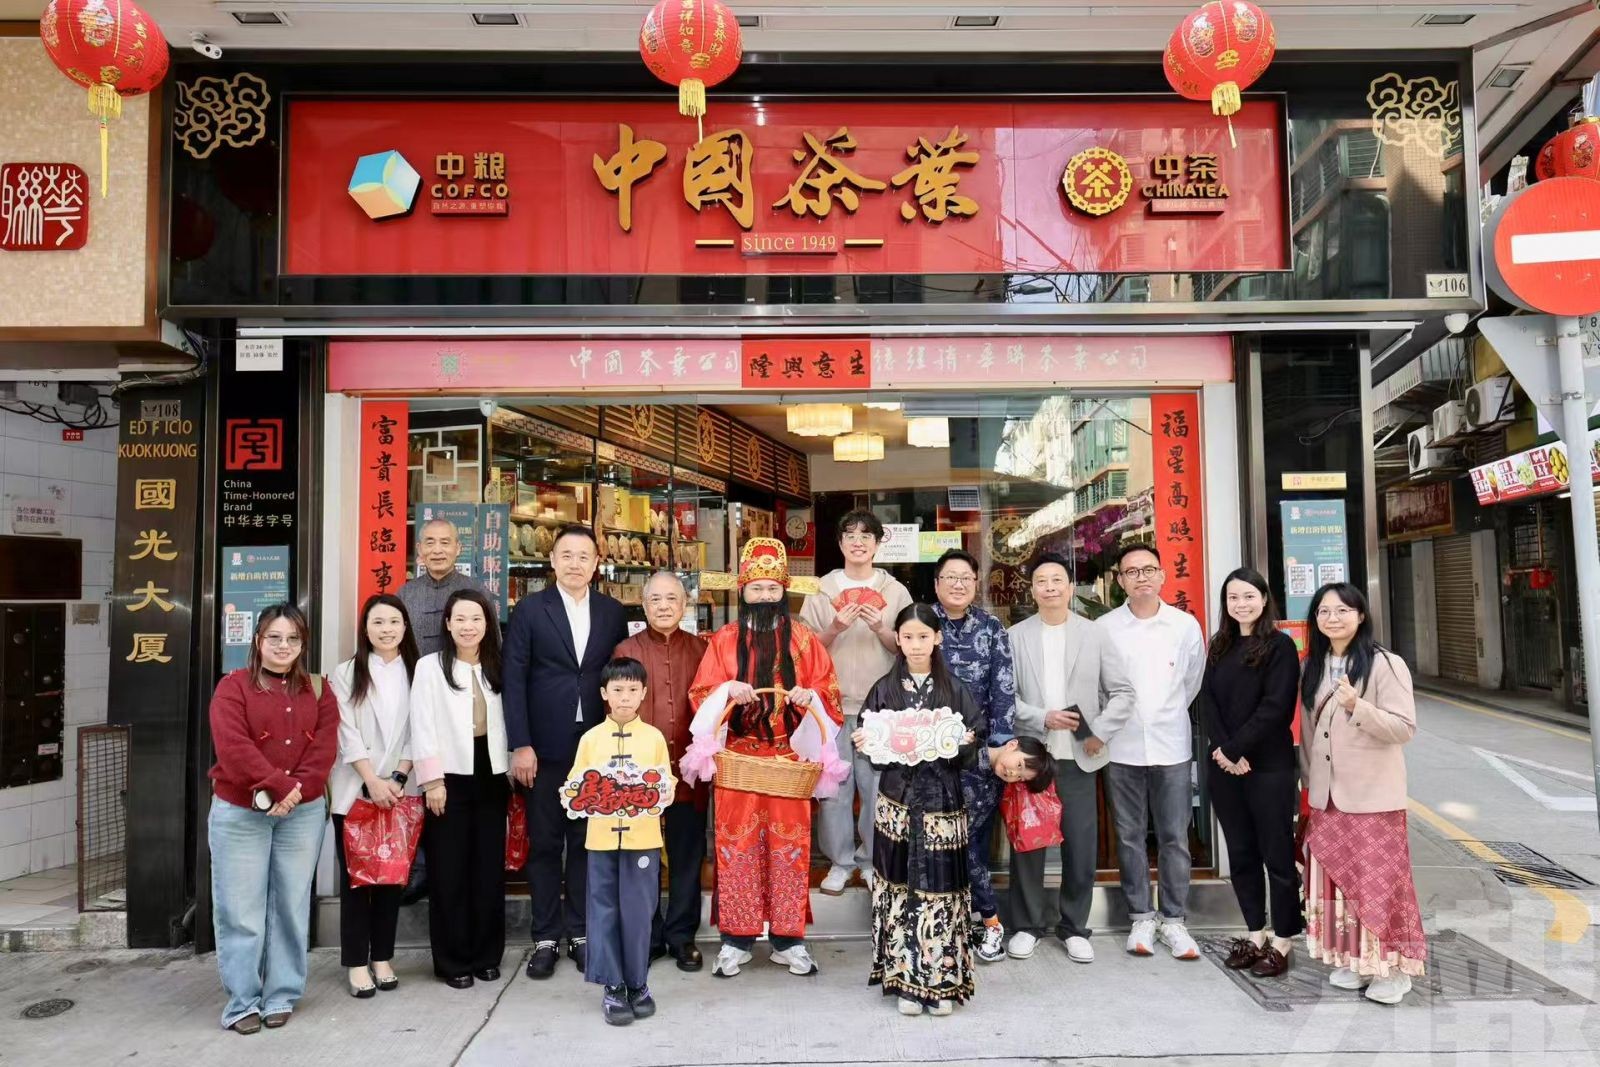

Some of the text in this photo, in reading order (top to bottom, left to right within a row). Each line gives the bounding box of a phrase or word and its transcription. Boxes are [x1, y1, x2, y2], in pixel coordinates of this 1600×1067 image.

[435, 152, 505, 180] 中粮
[1155, 152, 1218, 179] 中茶
[431, 184, 508, 198] COFCO
[1142, 183, 1231, 198] CHINATEA
[743, 232, 836, 252] since 1949
[1443, 277, 1466, 292] 106
[159, 403, 179, 418] 108
[223, 480, 252, 488] China
[223, 491, 295, 500] Time-Honored
[223, 503, 253, 511] Brand
[224, 514, 294, 527] 中华老字号
